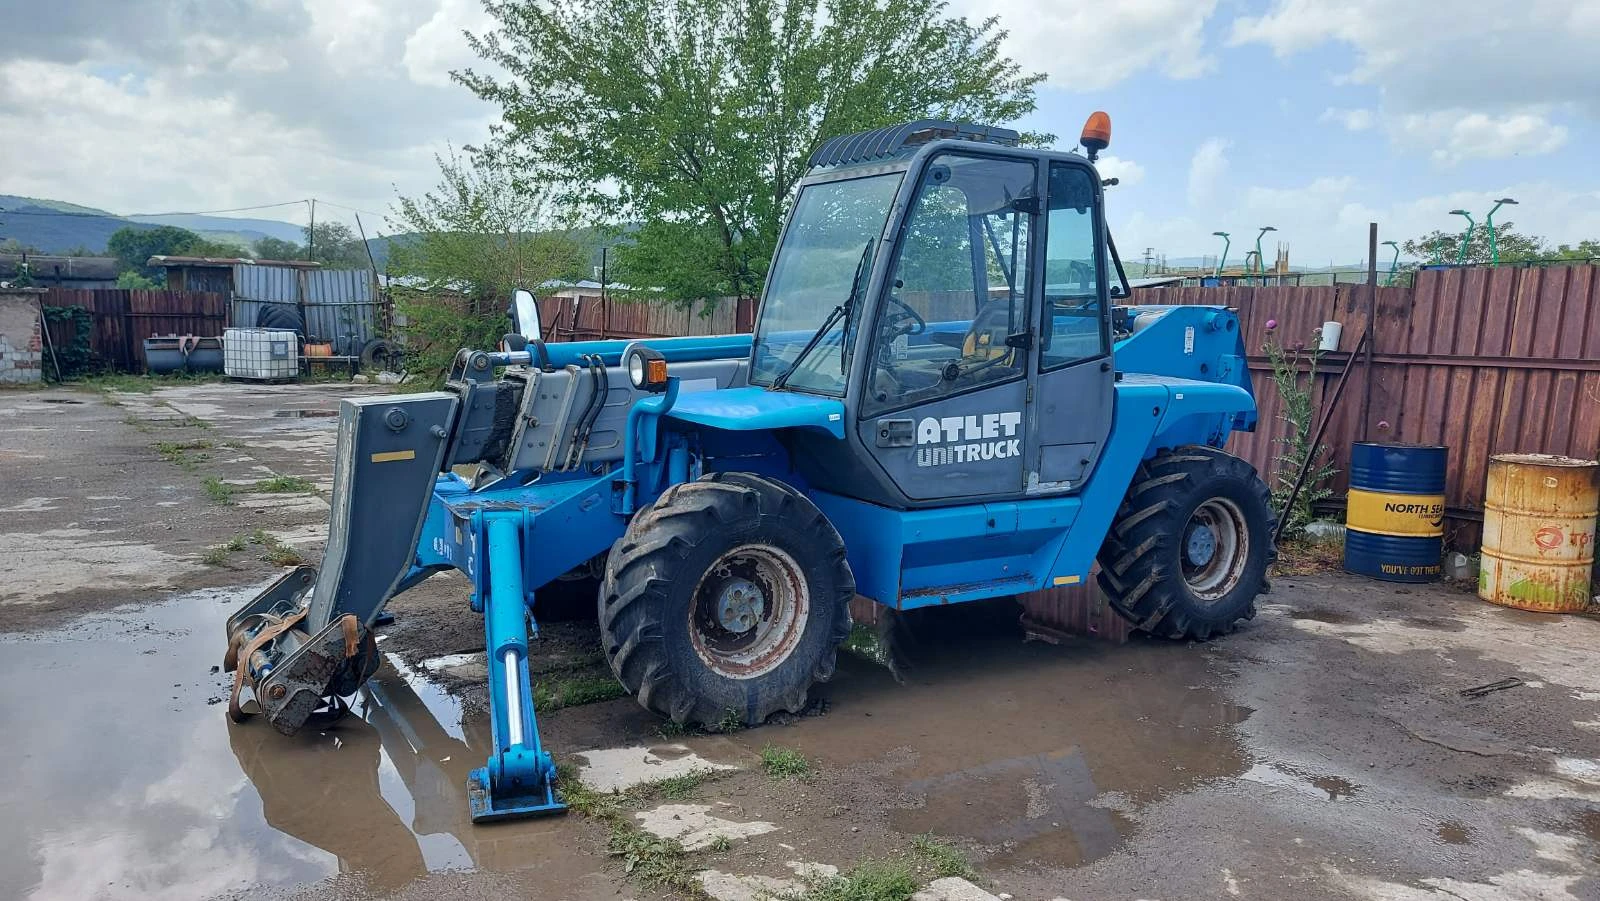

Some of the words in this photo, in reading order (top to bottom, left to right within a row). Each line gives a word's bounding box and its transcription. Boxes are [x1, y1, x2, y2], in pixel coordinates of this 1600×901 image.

[917, 411, 1021, 445] ATLET
[1384, 503, 1429, 514] NORTH
[1381, 563, 1408, 576] YOU'VE
[1410, 566, 1423, 576] GOT
